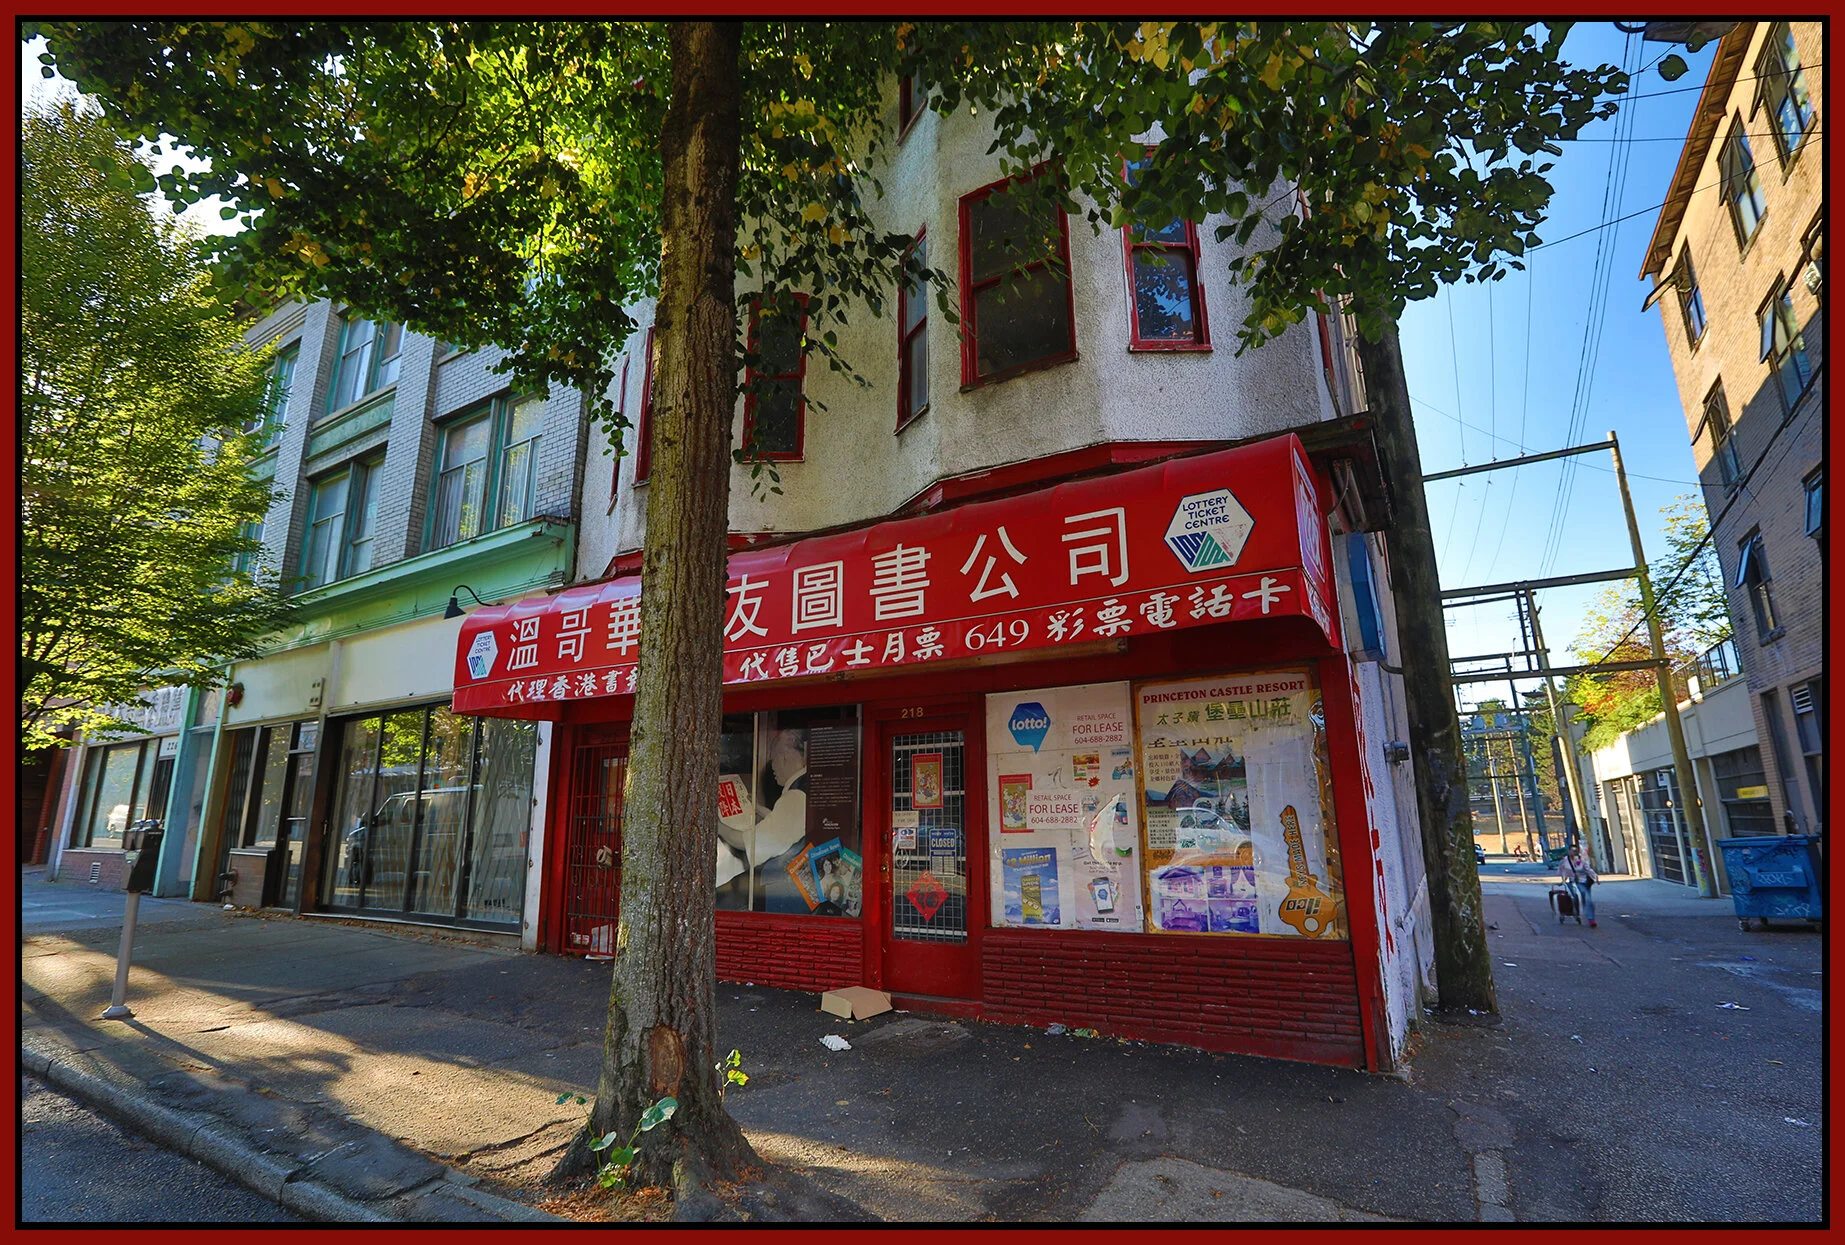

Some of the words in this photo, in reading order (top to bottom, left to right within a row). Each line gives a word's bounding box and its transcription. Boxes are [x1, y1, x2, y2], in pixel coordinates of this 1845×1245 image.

[1182, 496, 1228, 511] LOTTERY
[1188, 506, 1225, 519] TICKET
[1185, 515, 1229, 529] CENTRE
[740, 626, 945, 680] 代售巴士月票
[965, 619, 1029, 650] 649
[1047, 576, 1291, 642] 彩票電話卡
[1143, 689, 1207, 704] PRINCETON
[1210, 685, 1253, 697] CASTLE
[1256, 681, 1305, 693] RESORT
[901, 706, 924, 718] 218
[1098, 712, 1116, 720] SPACE
[1012, 717, 1047, 731] lotto!
[1072, 724, 1092, 735] FOR
[1094, 722, 1124, 733] LEASE
[1074, 735, 1123, 744] 604-688-2882
[1029, 804, 1048, 814] FOR
[1050, 803, 1079, 814] LEASE
[1031, 816, 1078, 824] 604-688-2882
[1285, 815, 1298, 836] HERE
[931, 838, 955, 848] CLOSED
[1290, 838, 1303, 863] MADE
[1018, 853, 1051, 866] Million
